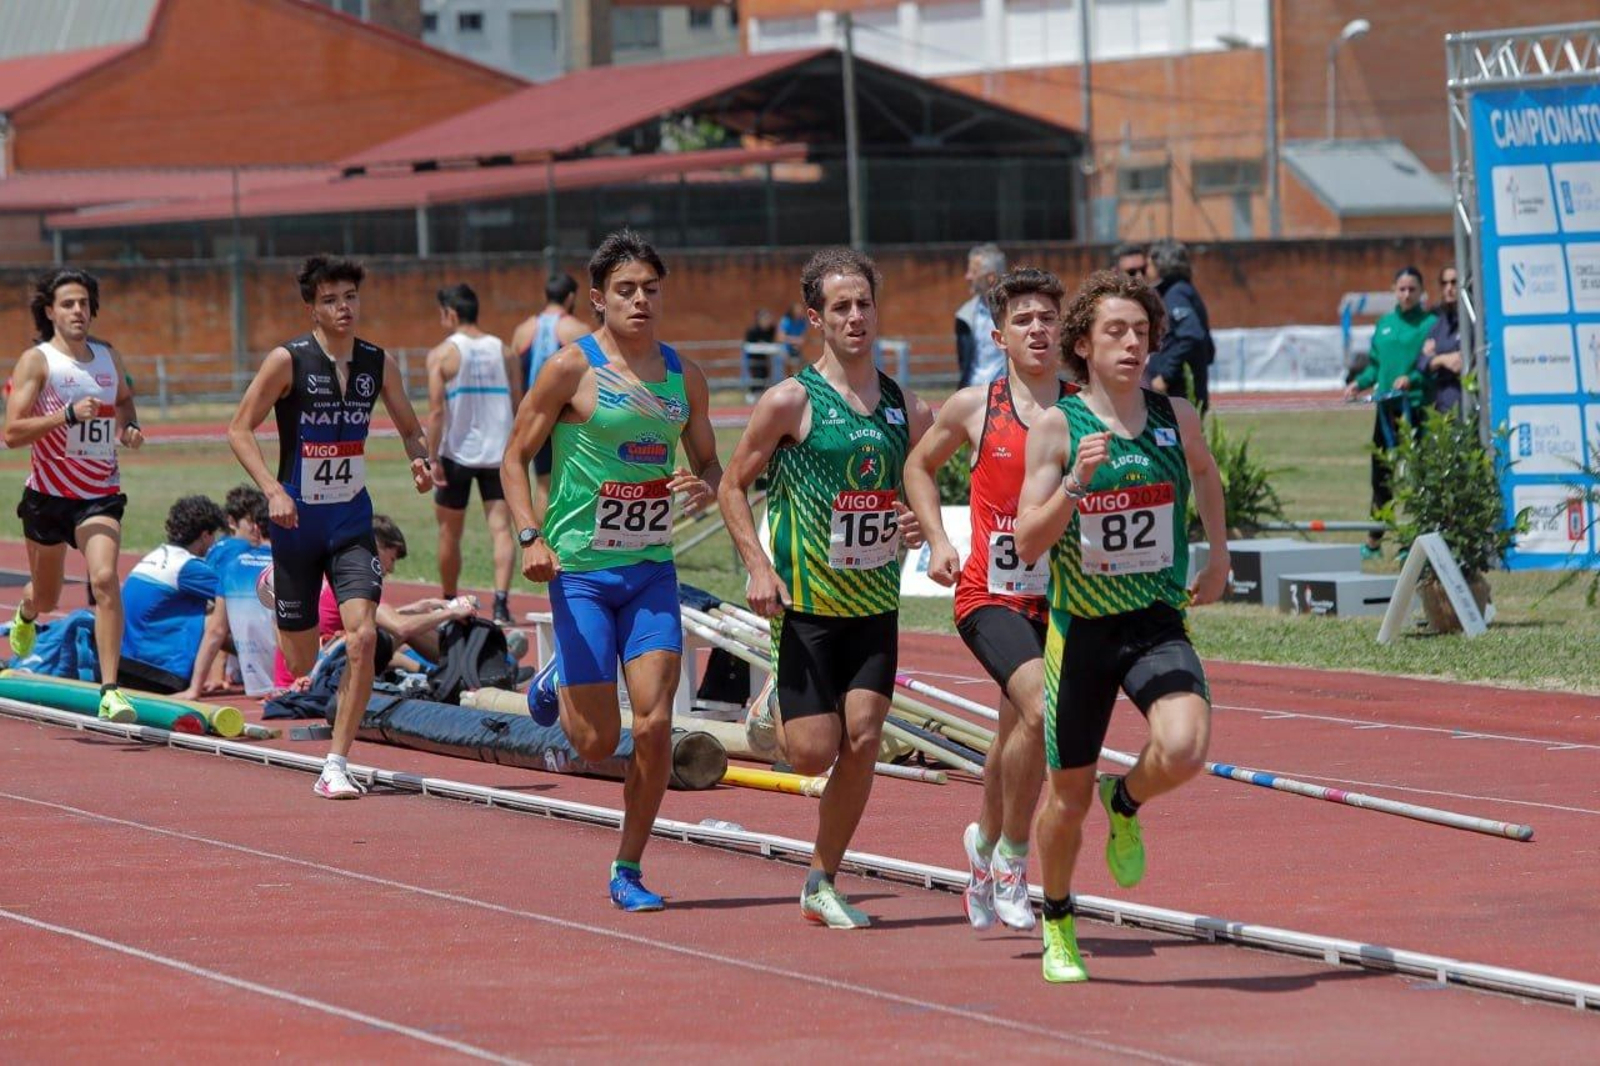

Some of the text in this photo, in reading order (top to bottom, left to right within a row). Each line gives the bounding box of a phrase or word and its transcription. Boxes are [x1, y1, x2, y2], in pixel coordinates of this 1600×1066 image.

[1490, 103, 1600, 149] CAMPIONATO
[80, 420, 110, 443] 161
[849, 428, 882, 441] LUCUS
[305, 444, 338, 457] VIGO
[1111, 454, 1150, 469] LUCUS
[314, 458, 353, 486] 44
[605, 484, 644, 499] VIGO
[836, 494, 878, 510] VIGO
[1081, 486, 1172, 512] VIGO 2024
[600, 499, 669, 532] 282
[840, 511, 898, 548] 165
[1101, 510, 1157, 552] 82
[995, 534, 1037, 572] 3
